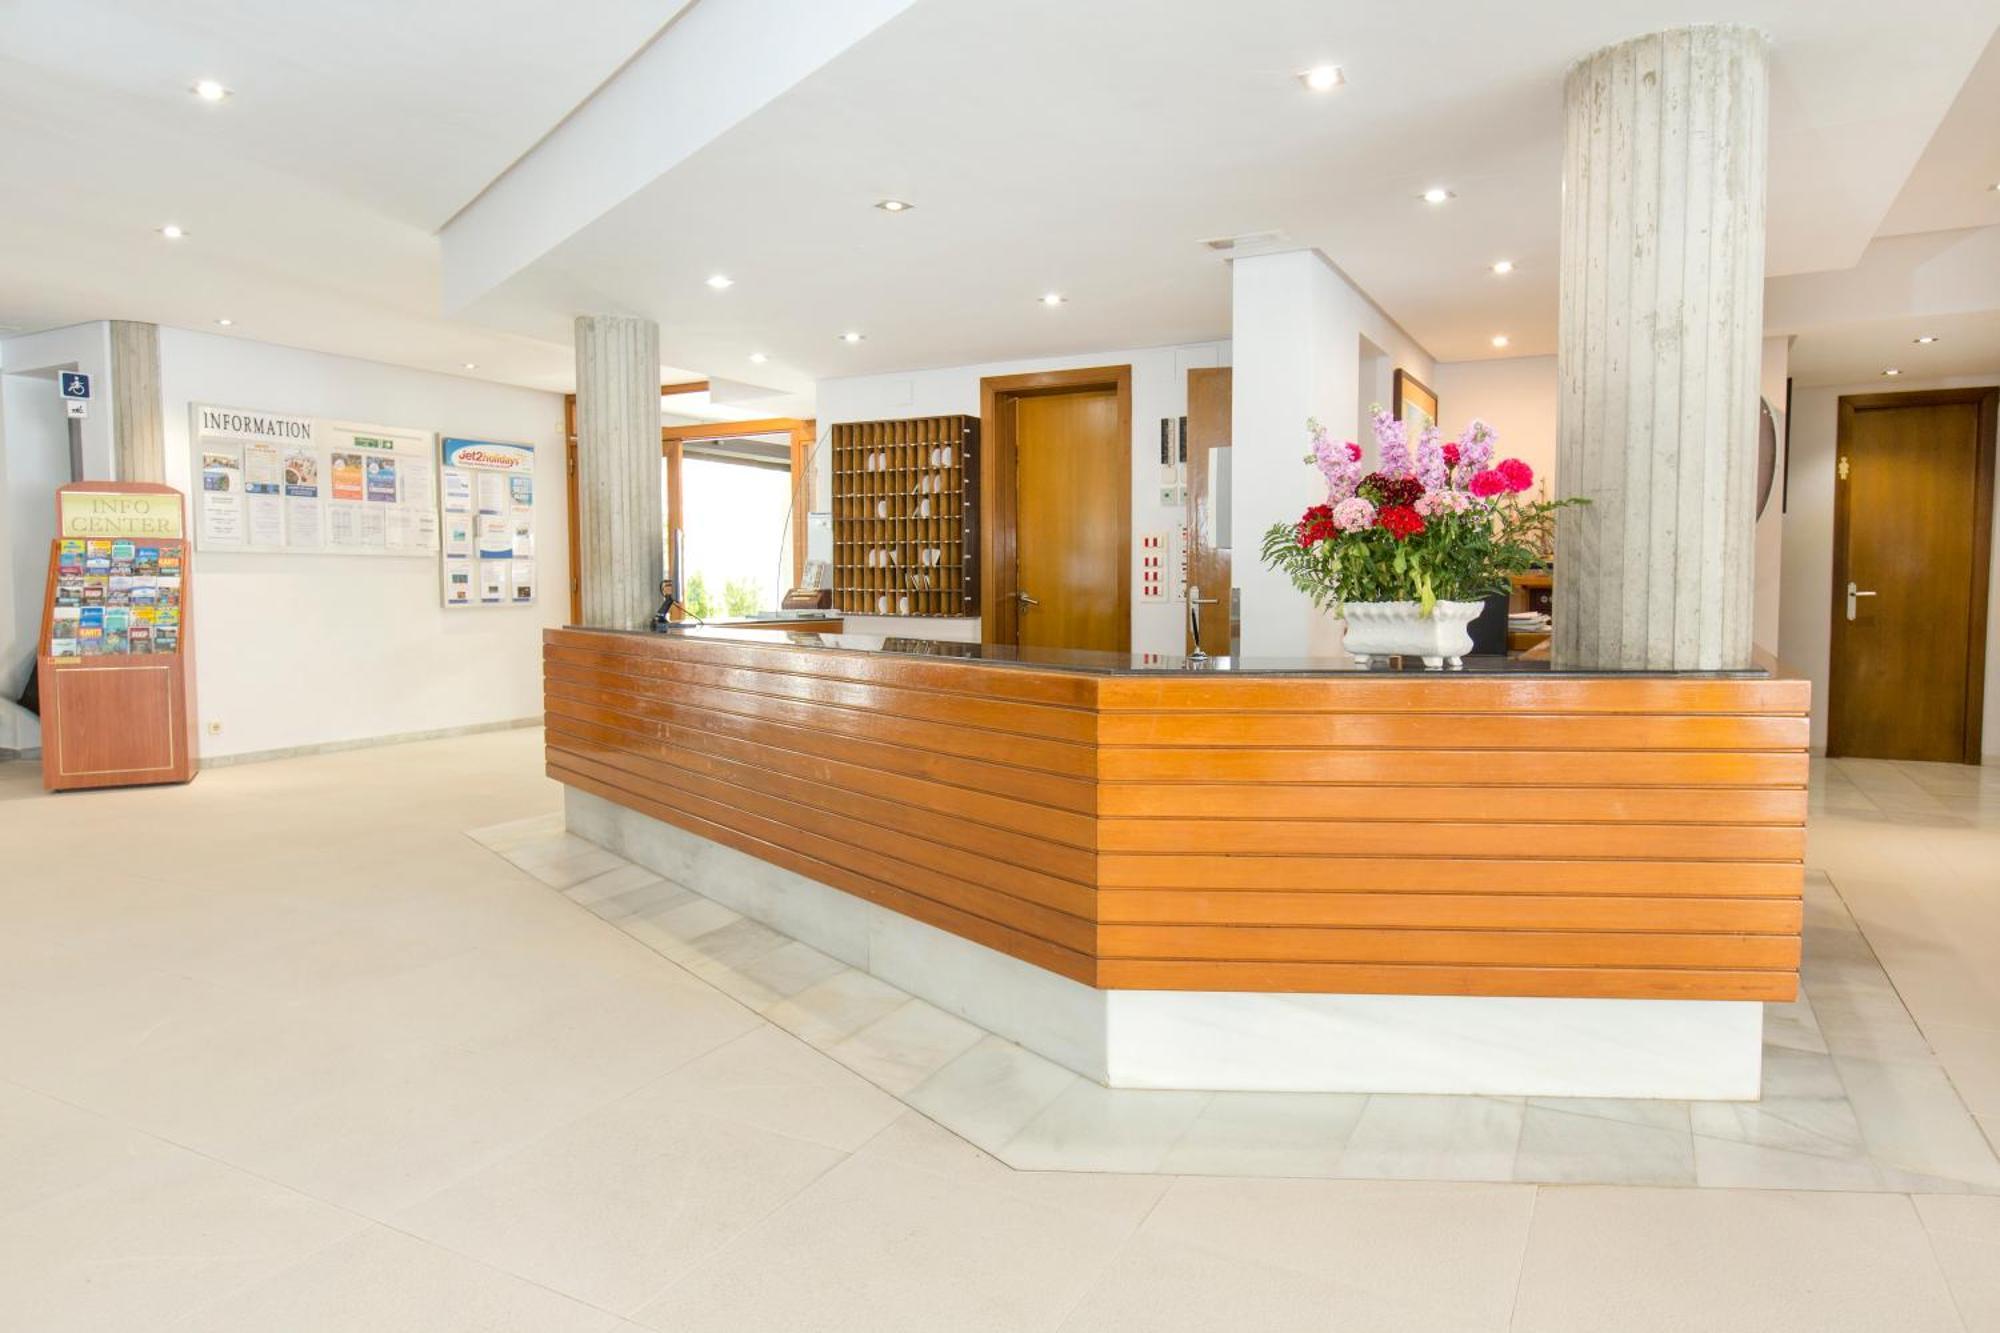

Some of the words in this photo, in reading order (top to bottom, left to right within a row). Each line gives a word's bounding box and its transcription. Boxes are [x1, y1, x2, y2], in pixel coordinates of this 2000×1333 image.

[204, 411, 310, 439] INFORMATION
[93, 499, 150, 514] INFO
[71, 516, 170, 533] CENTER
